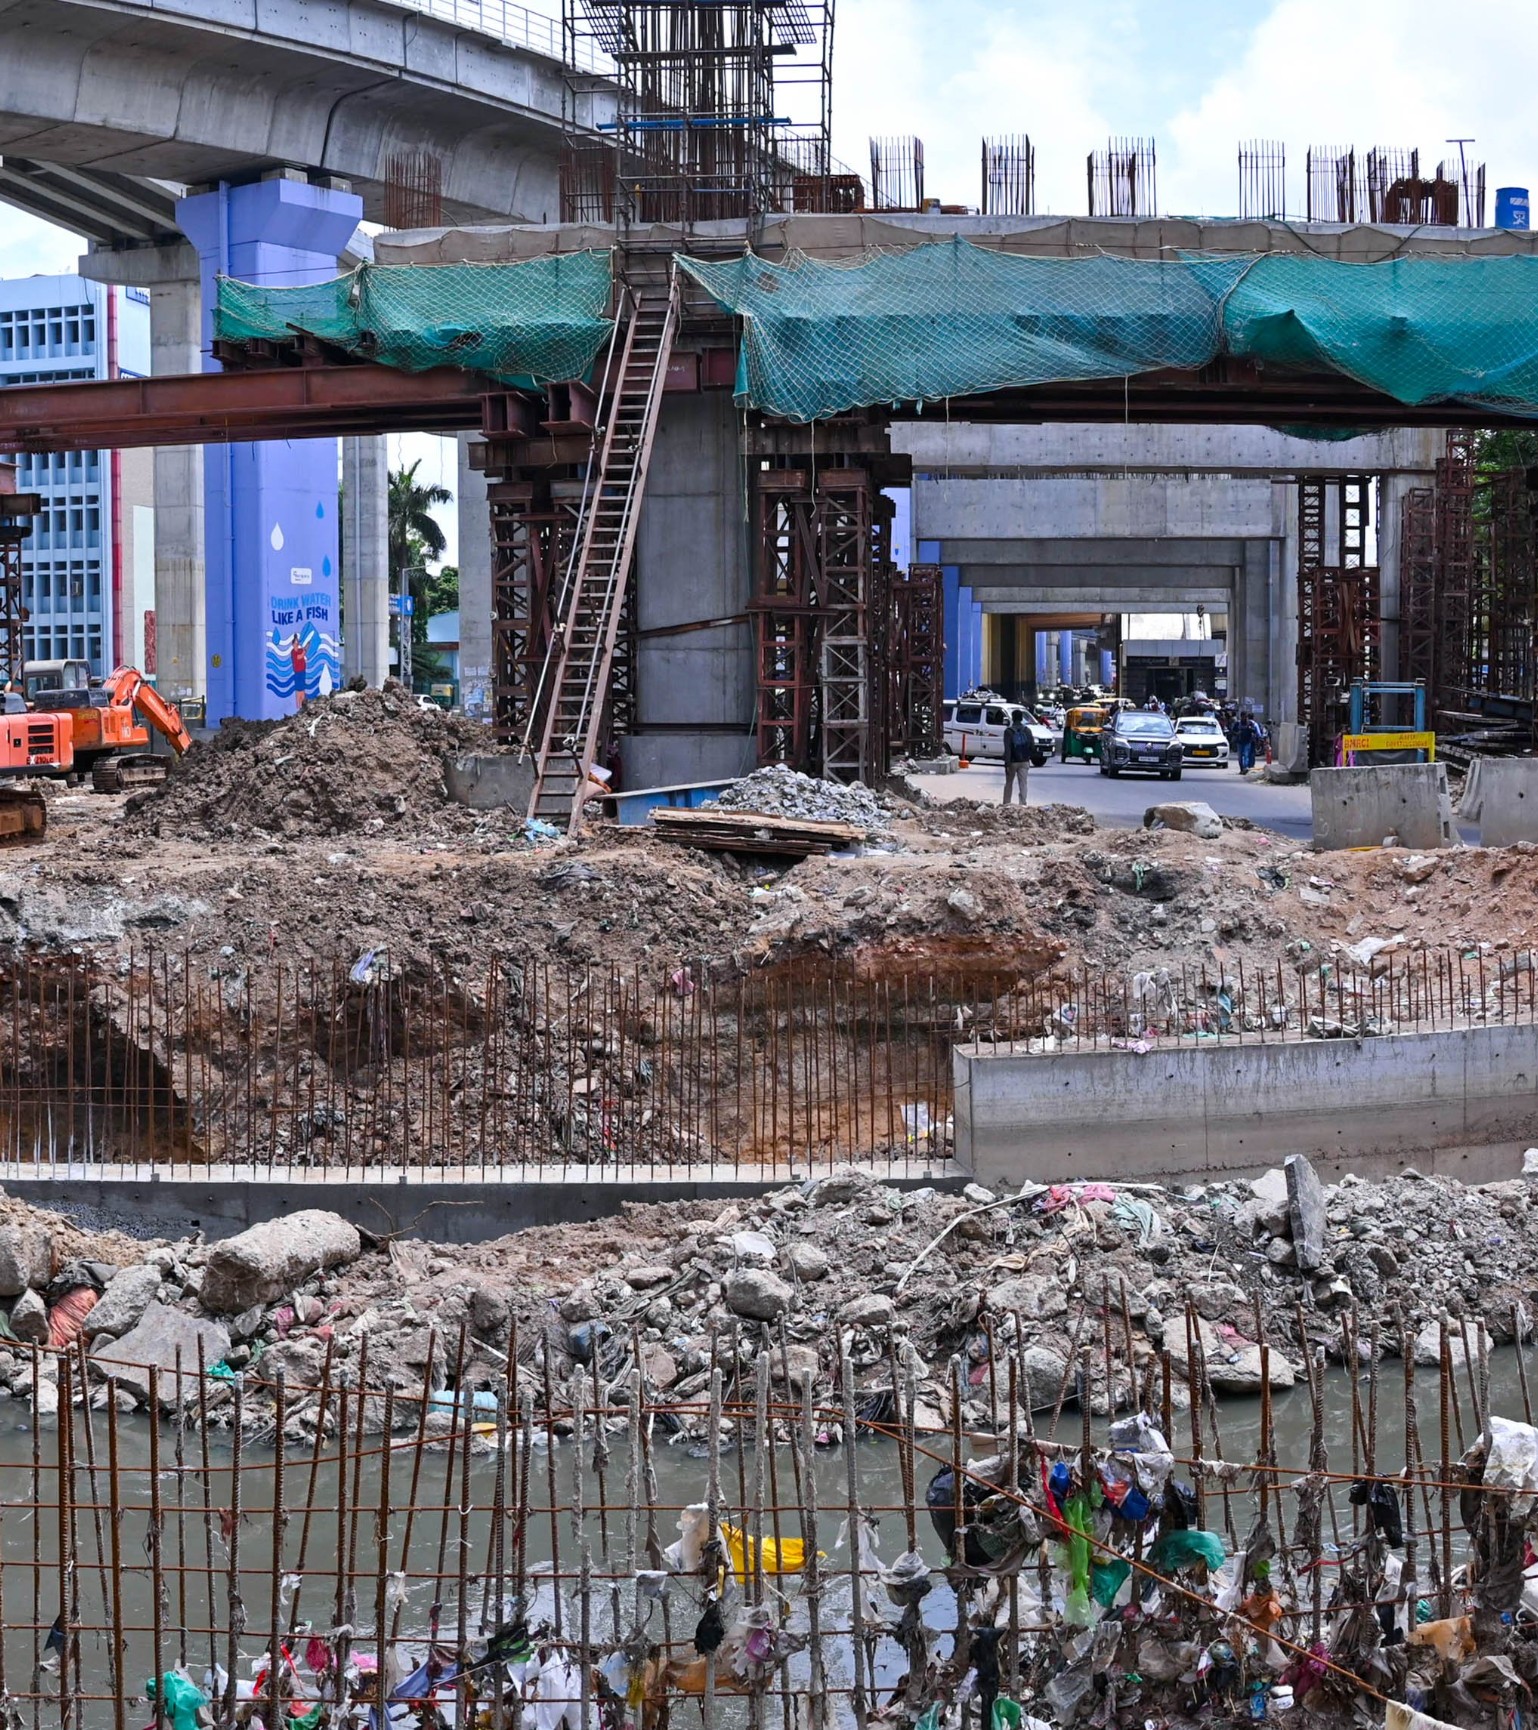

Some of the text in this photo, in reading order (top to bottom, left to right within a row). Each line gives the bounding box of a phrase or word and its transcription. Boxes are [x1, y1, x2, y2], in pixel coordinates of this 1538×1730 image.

[271, 592, 331, 610] DRINK WATER
[271, 605, 329, 626] LIKE A FISH
